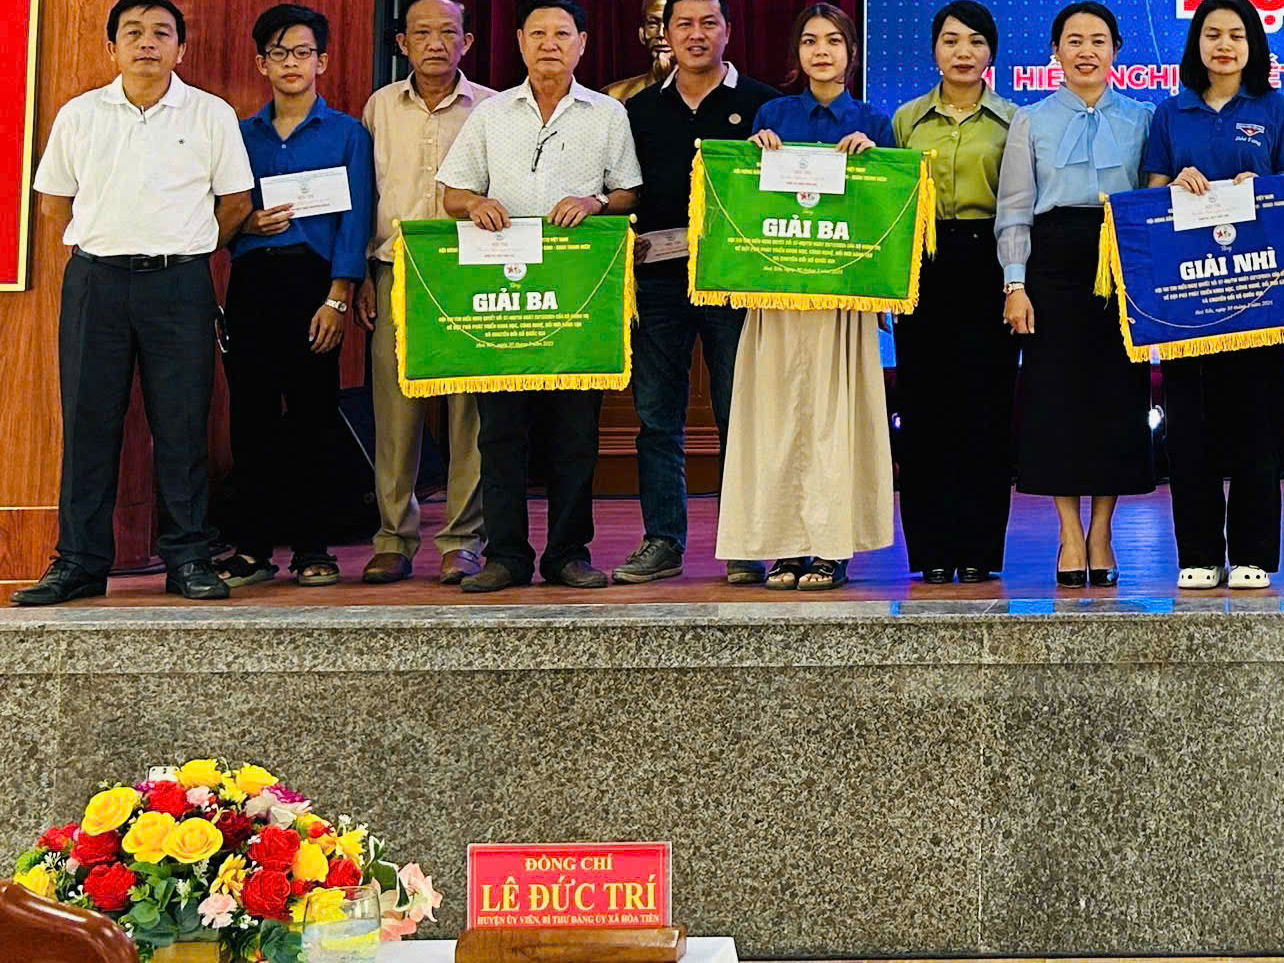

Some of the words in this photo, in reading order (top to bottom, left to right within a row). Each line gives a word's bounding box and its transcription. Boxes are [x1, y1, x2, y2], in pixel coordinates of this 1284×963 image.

[1106, 64, 1180, 95] NGHỊ
[763, 214, 812, 239] GIẢI
[818, 220, 850, 241] BA
[1179, 253, 1228, 281] GIẢI
[1233, 246, 1277, 275] NHÌ
[472, 287, 521, 313] GIẢI
[526, 290, 559, 311] BA
[525, 855, 575, 871] ĐỒNG
[580, 853, 613, 871] CHÍ
[480, 875, 521, 912] LÊ
[528, 875, 595, 912] ĐỨC
[603, 873, 656, 911] TRÍ
